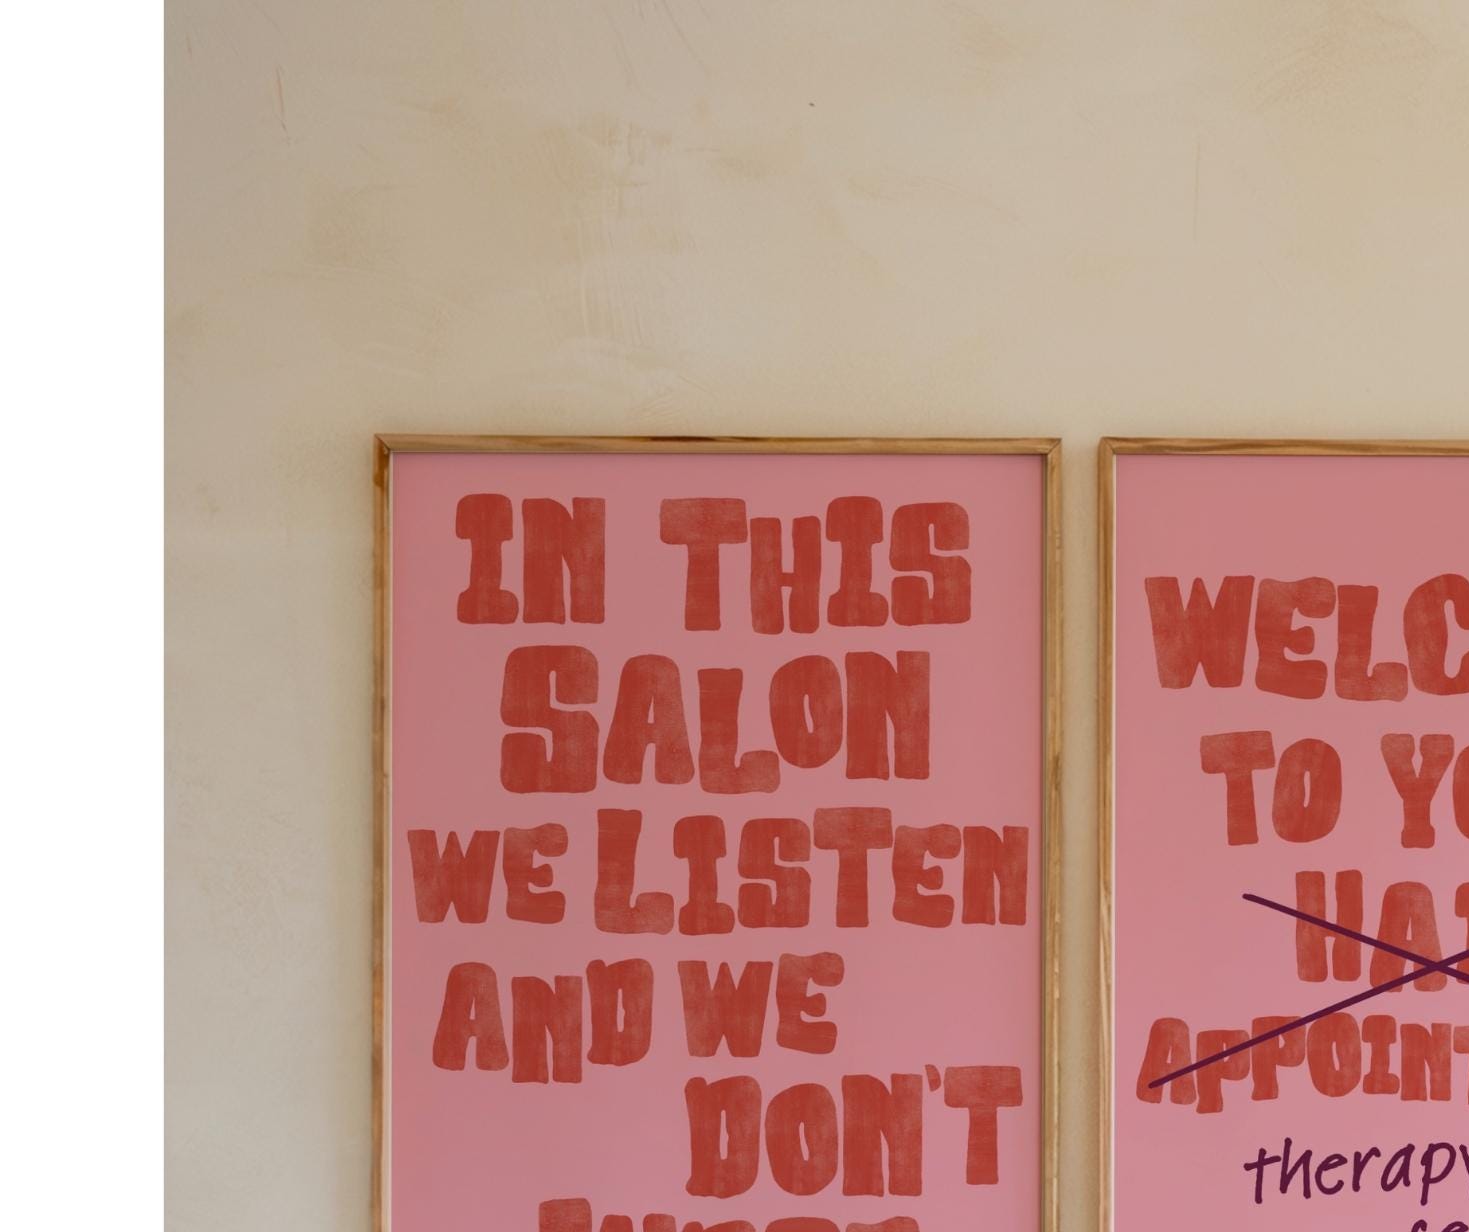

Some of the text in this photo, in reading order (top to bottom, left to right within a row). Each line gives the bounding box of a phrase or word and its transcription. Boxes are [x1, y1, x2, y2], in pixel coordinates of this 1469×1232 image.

[450, 489, 973, 636] IN THIS
[498, 643, 933, 796] SALON
[1199, 728, 1344, 848] TO
[406, 805, 1030, 937] WE LISTEN
[431, 950, 846, 1087] AND WE
[683, 1063, 1024, 1200] DON'T
